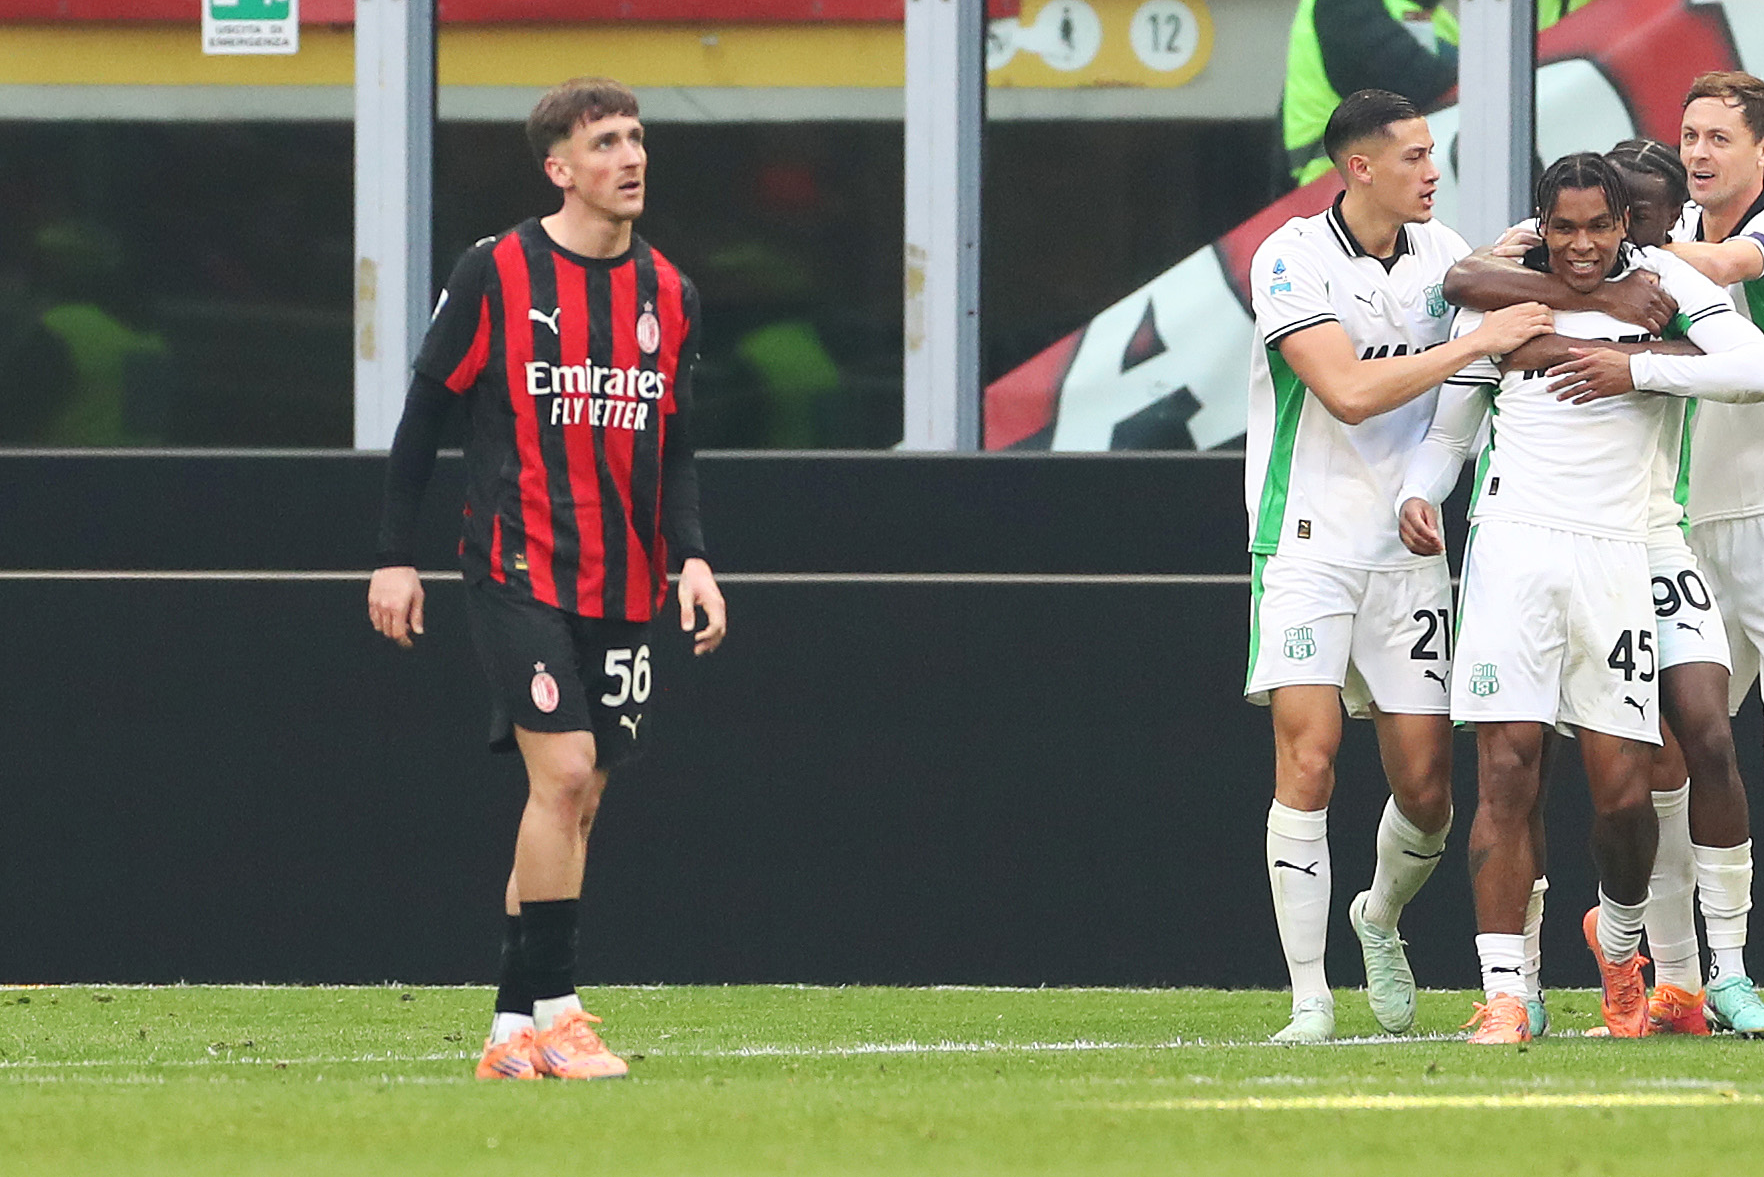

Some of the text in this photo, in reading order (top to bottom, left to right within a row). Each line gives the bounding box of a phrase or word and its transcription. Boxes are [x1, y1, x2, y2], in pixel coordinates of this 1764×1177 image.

[1147, 13, 1182, 54] 12
[524, 358, 667, 400] Emirates
[551, 396, 585, 426] FLY
[1651, 569, 1711, 618] 90
[1410, 608, 1451, 661] 21
[1607, 629, 1655, 682] 45
[601, 644, 652, 707] 56
